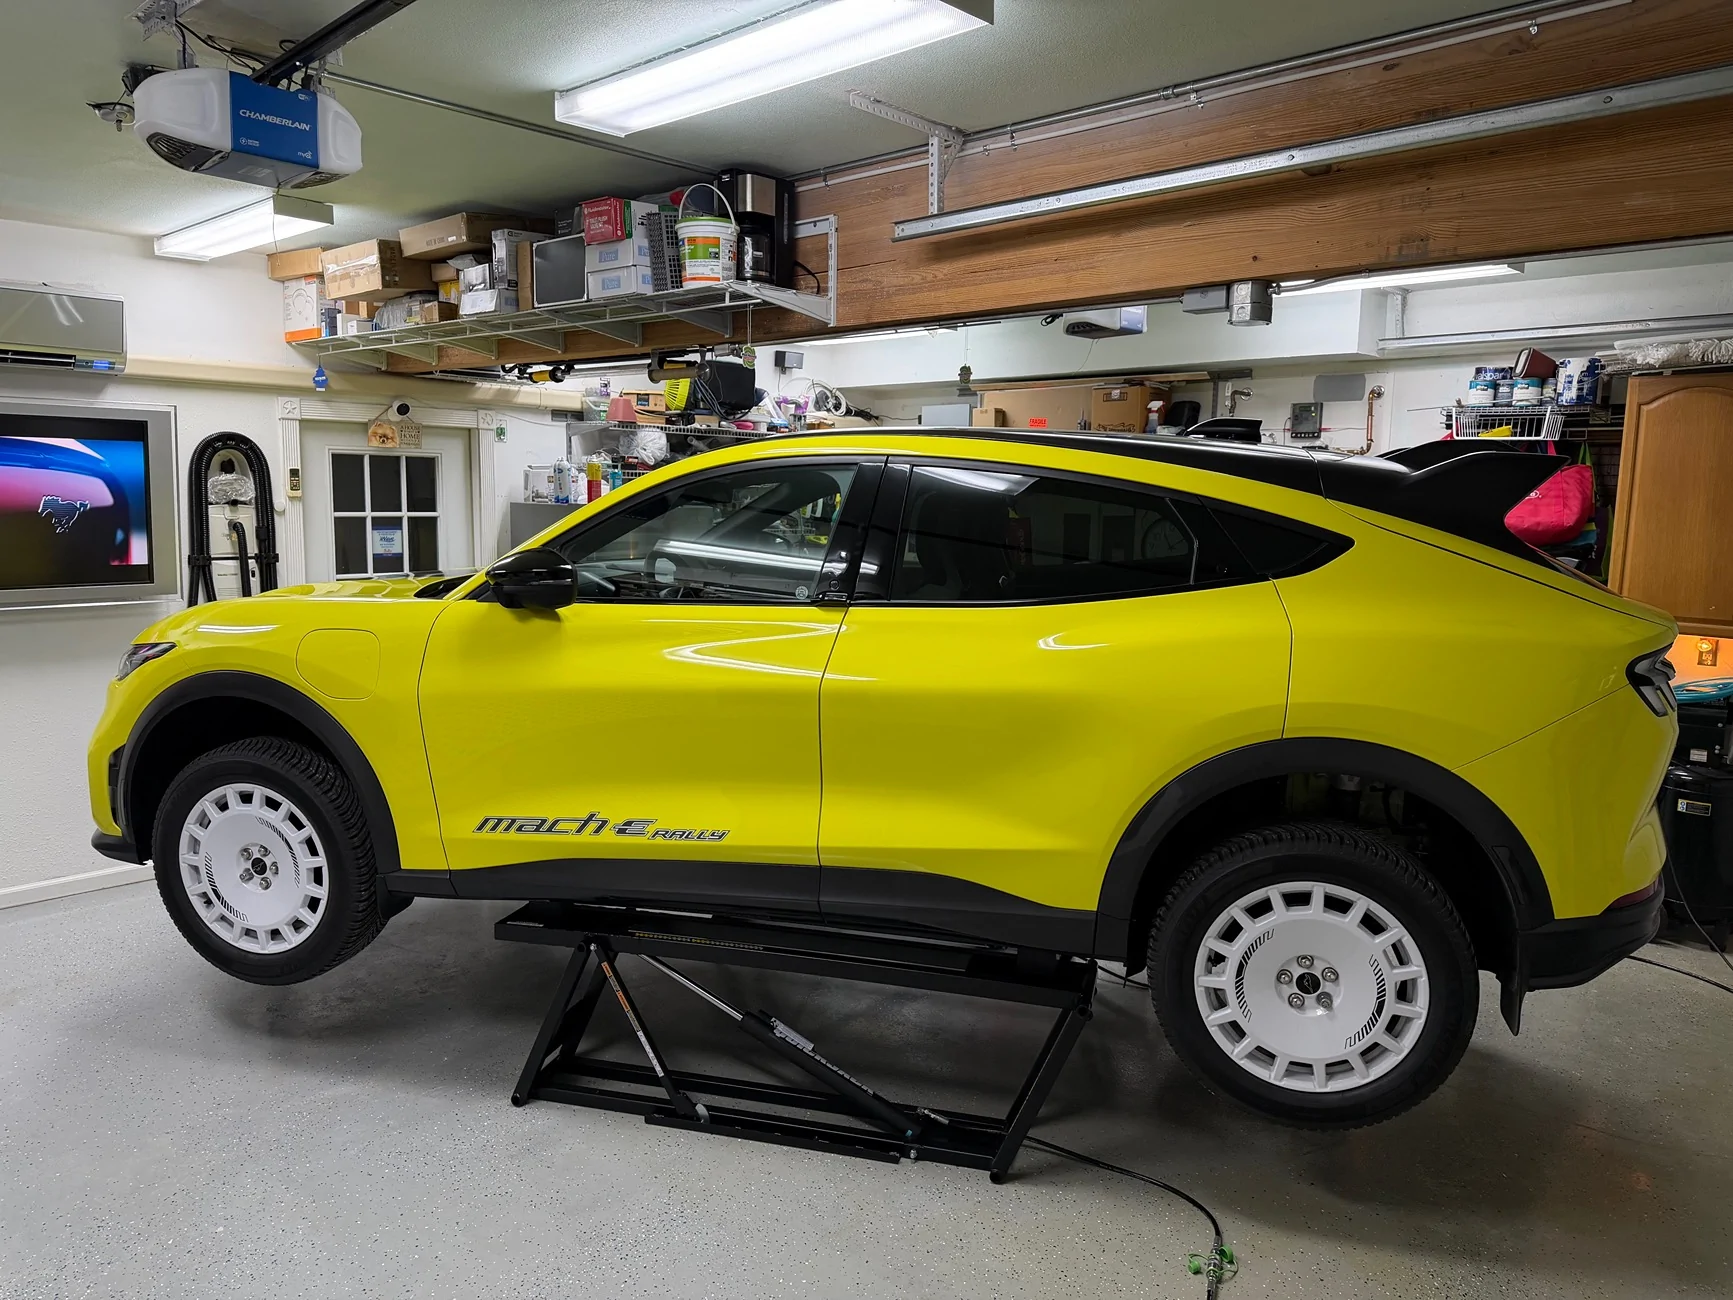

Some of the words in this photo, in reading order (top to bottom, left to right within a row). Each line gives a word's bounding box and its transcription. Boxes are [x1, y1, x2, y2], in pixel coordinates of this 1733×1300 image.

[239, 109, 310, 131] CHAMBERLAIN
[602, 251, 616, 261] Pure
[647, 828, 730, 842] RALLY
